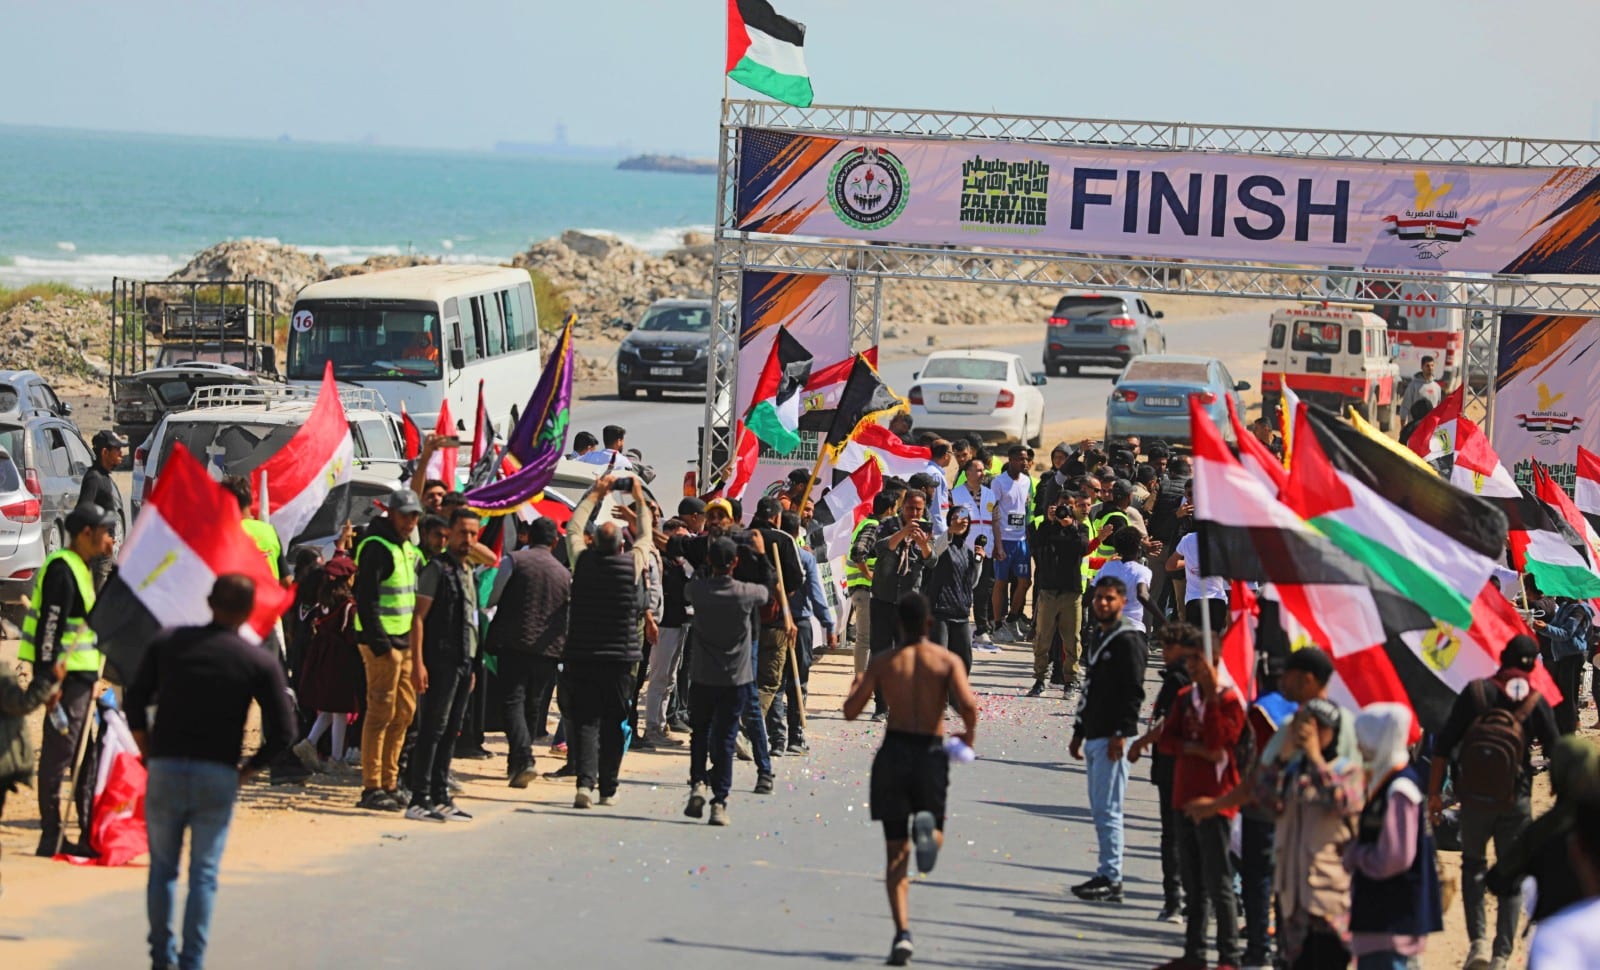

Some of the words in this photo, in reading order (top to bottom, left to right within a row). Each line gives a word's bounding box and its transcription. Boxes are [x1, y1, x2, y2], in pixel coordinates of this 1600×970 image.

[961, 193, 1047, 212] PALESTINE
[1070, 167, 1350, 244] FINISH
[960, 207, 1047, 226] MARATHON
[1405, 209, 1434, 219] المصرية
[1436, 210, 1457, 220] اللجنة
[1286, 308, 1354, 320] AMBULANCE
[1405, 293, 1437, 319] 101
[295, 315, 312, 329] 16
